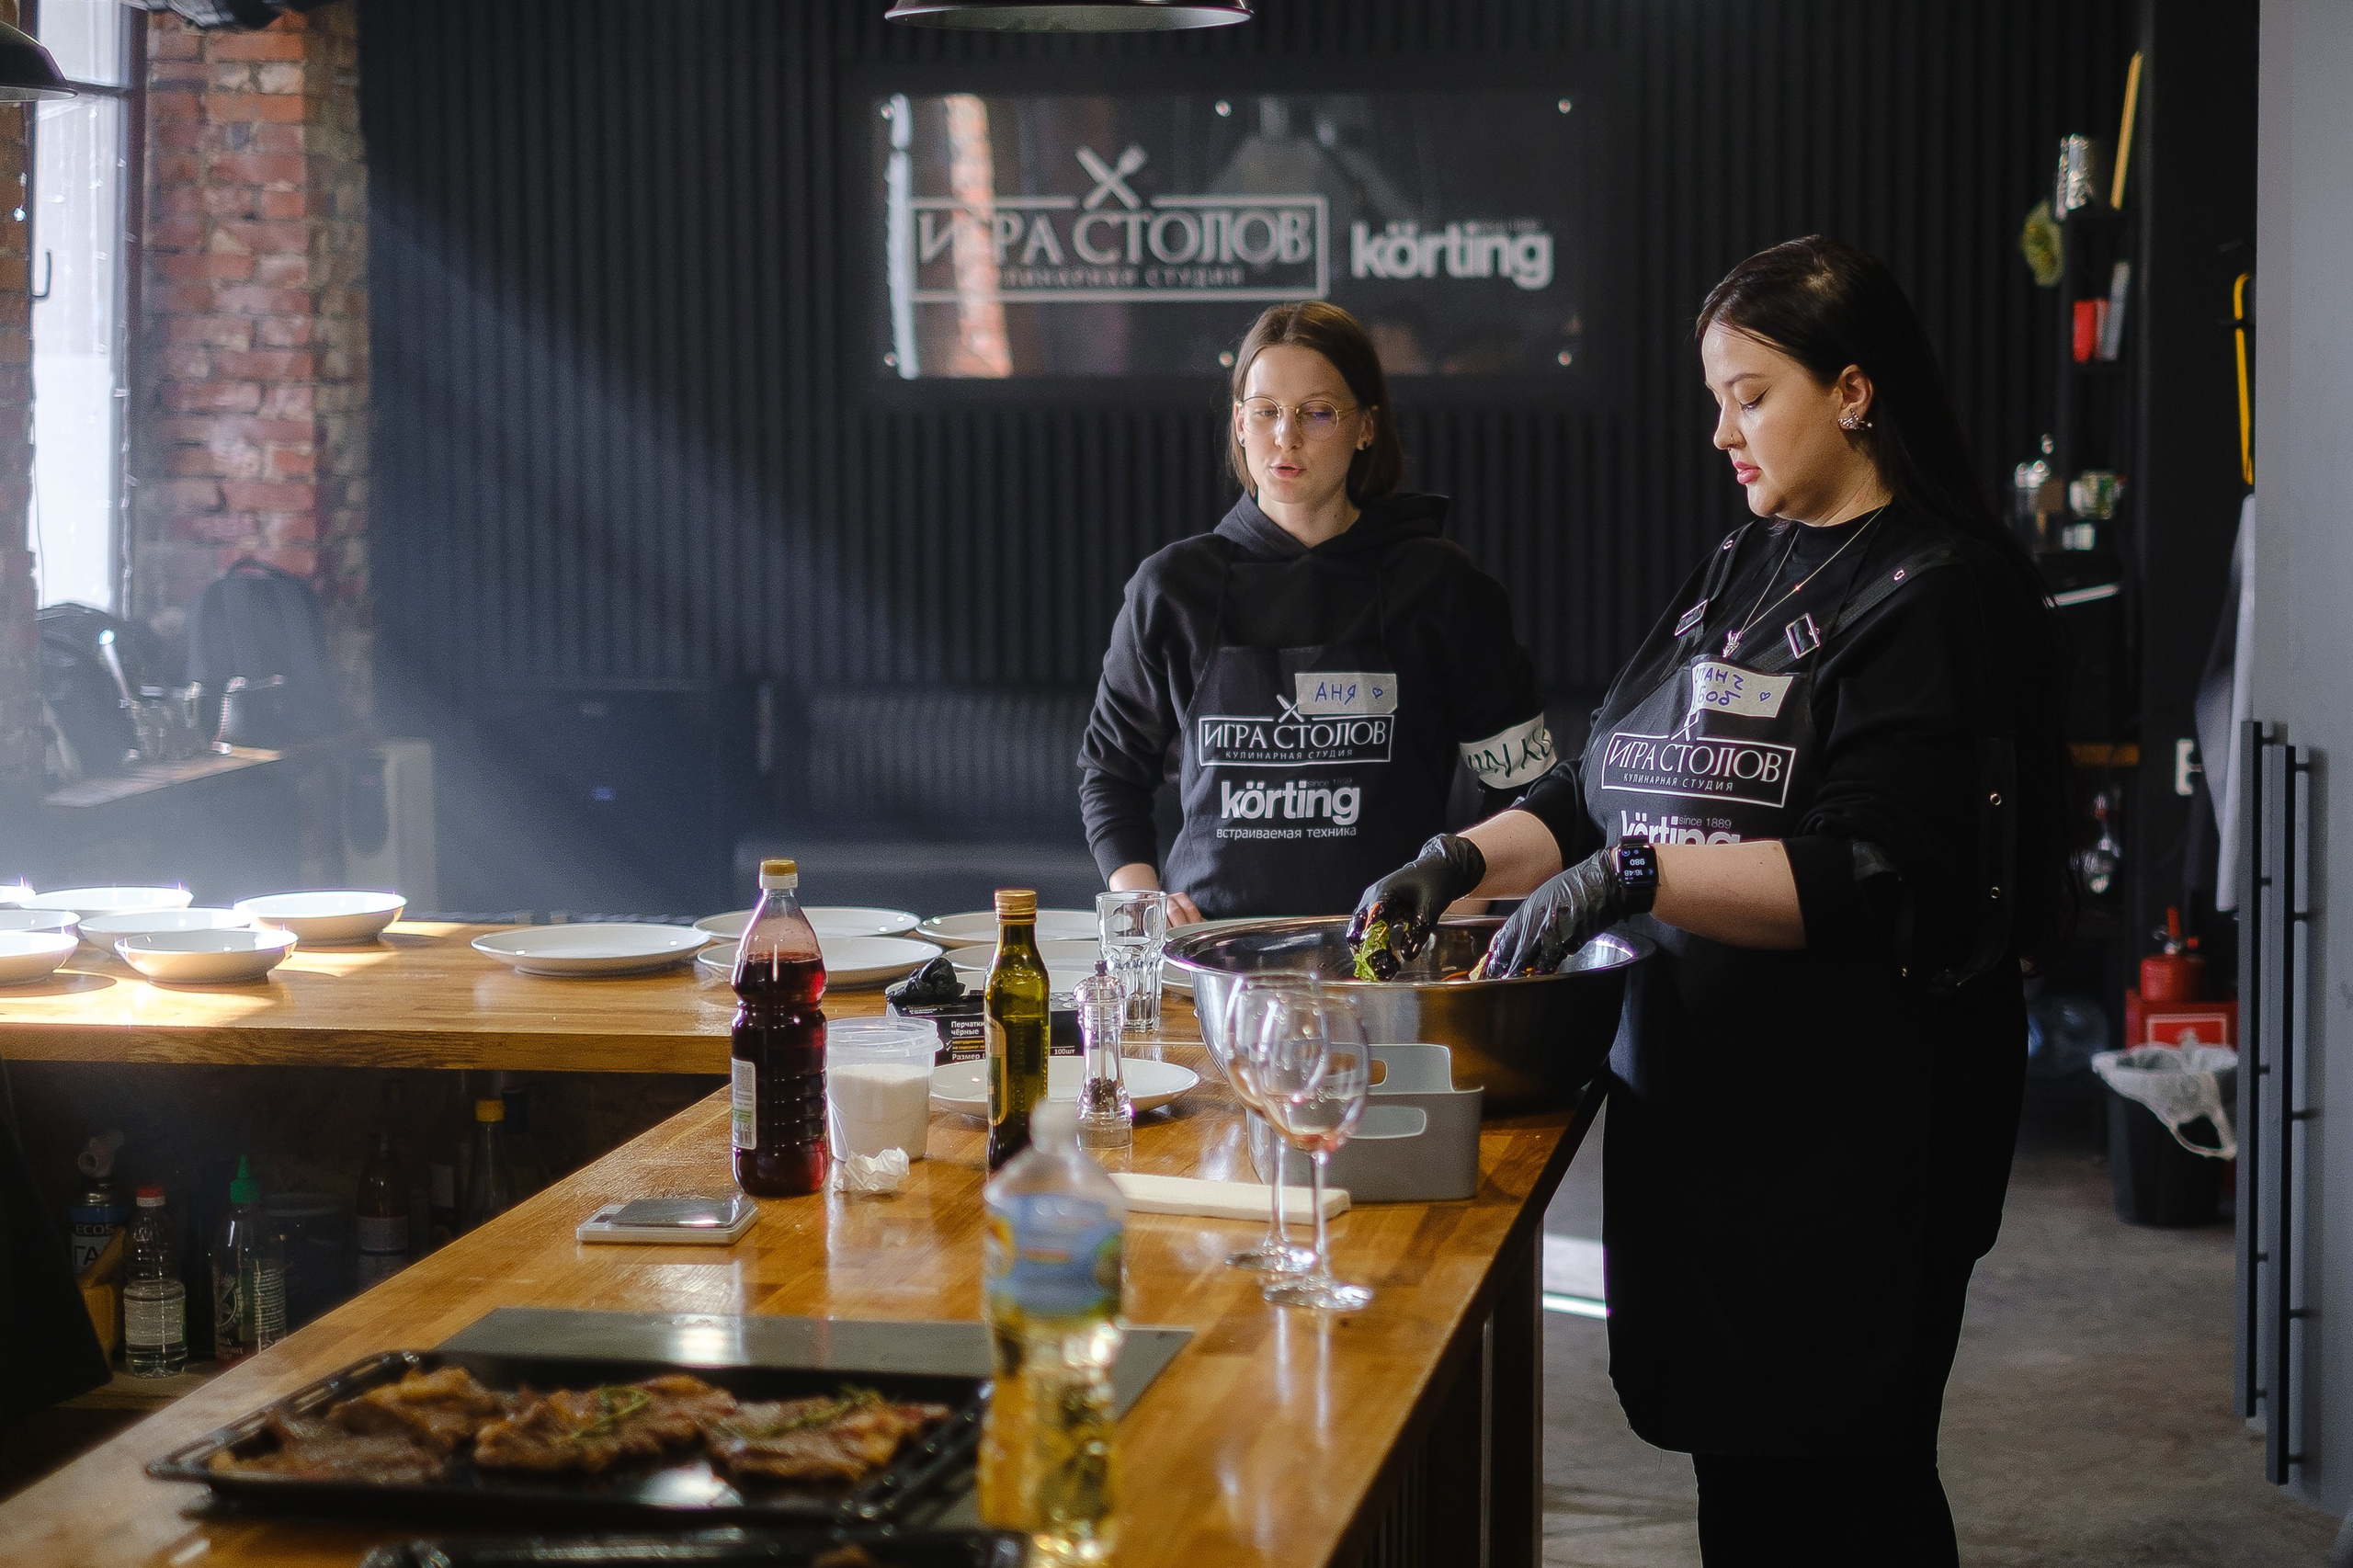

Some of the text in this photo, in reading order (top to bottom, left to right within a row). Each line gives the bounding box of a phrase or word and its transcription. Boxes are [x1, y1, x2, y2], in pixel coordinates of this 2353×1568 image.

[1351, 221, 1555, 290] körting
[1314, 681, 1358, 705] АНЯ
[1204, 721, 1387, 748] ИГРА СТОЛОВ
[1225, 749, 1353, 761] КУЛИНАРНАЯ СТУДИЯ
[1608, 740, 1783, 783] ИГРА СТОЛОВ
[1623, 772, 1733, 792] КУЛИНАРНАЯ СТУДИЯ
[1221, 780, 1360, 825] körting
[1678, 815, 1732, 829] since 1889
[1216, 826, 1358, 841] встраиваемая техника
[951, 1028, 979, 1037] чёрные
